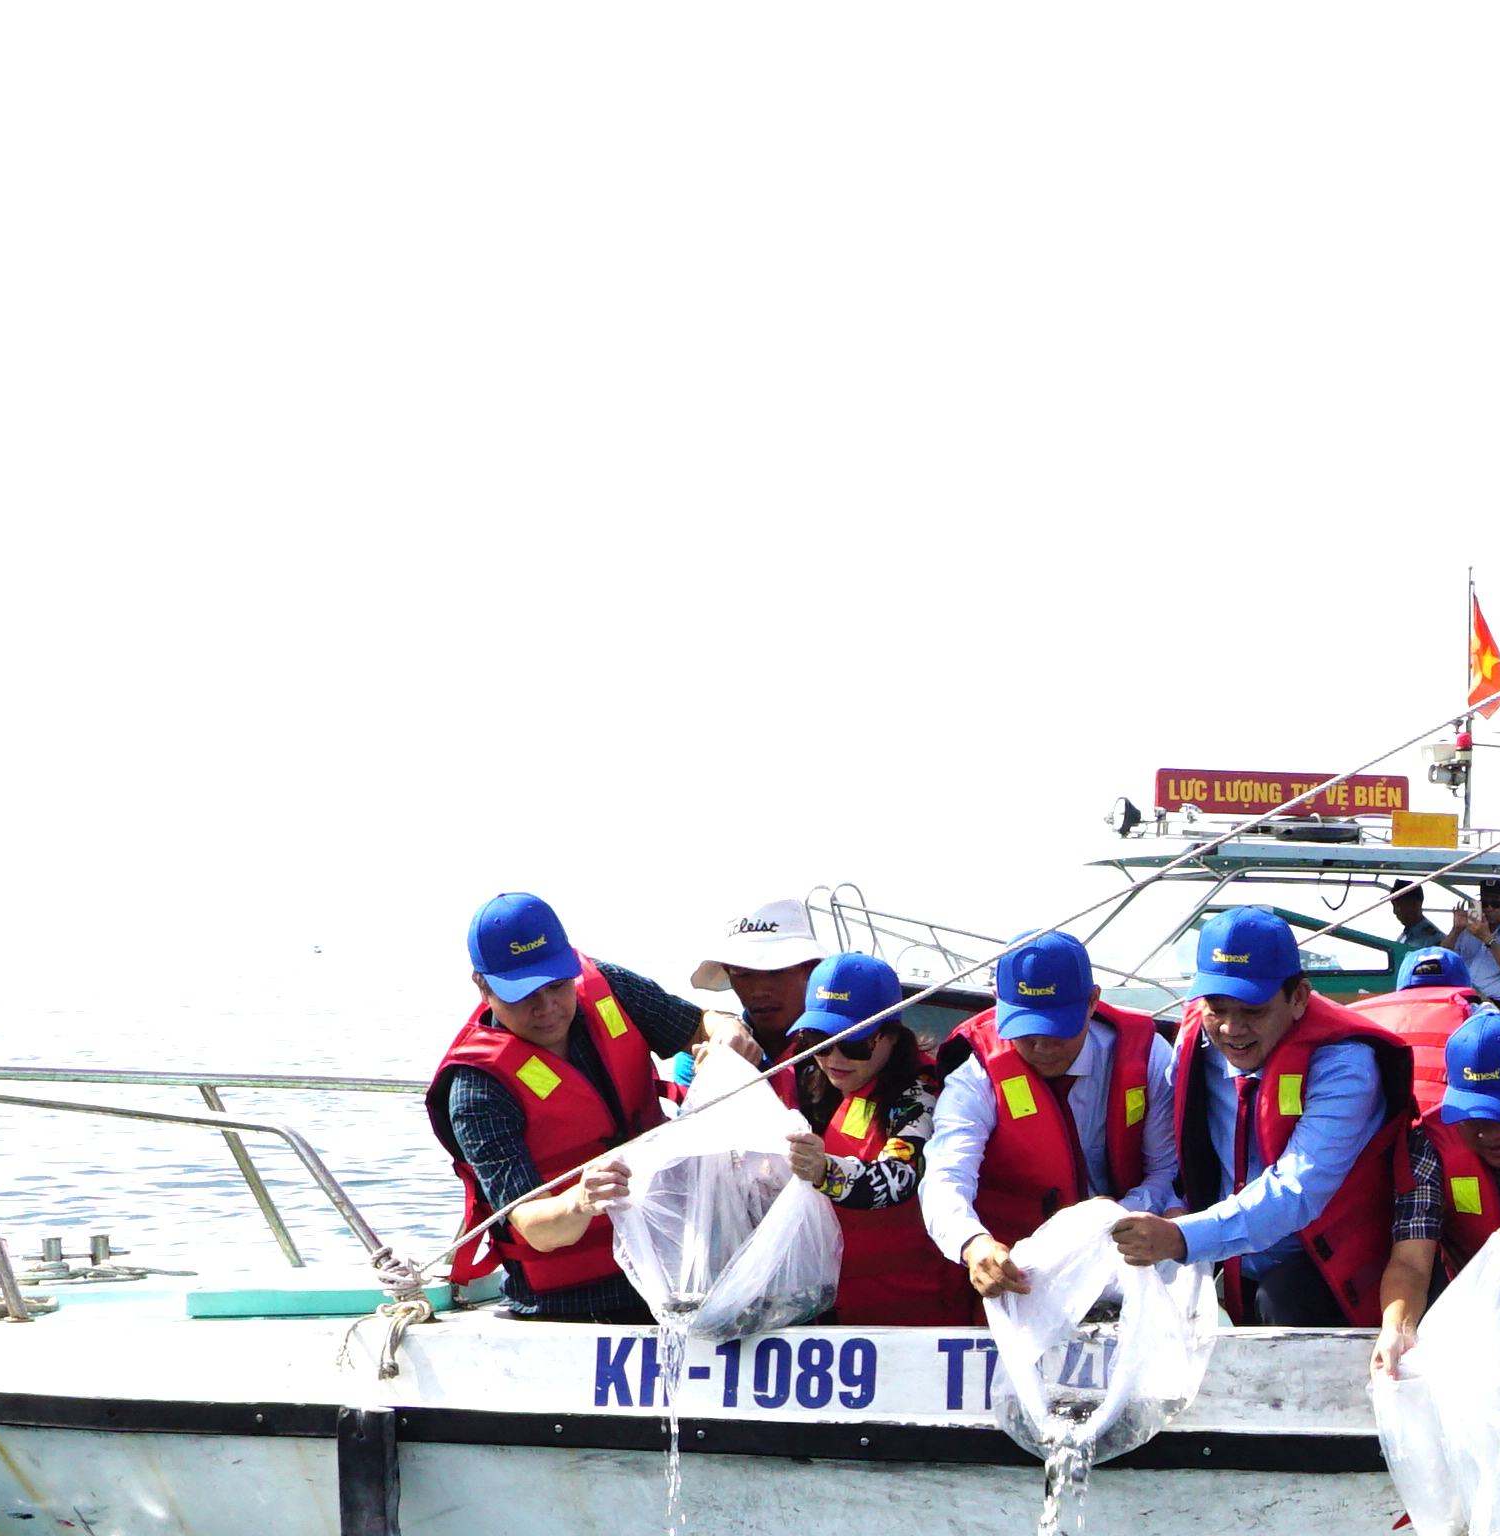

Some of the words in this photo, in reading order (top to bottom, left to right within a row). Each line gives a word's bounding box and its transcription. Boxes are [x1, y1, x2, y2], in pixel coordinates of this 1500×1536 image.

[1214, 778, 1283, 808] LƯỢNG
[1324, 781, 1349, 811] VỆ
[1354, 777, 1403, 808] BIỂN
[509, 934, 548, 955] Sanest
[1211, 947, 1250, 963] Sanest
[815, 985, 850, 1001] Sanest
[1018, 981, 1056, 996] Sanest
[1463, 1067, 1500, 1081] Sanest
[594, 1337, 877, 1409] KH-1089
